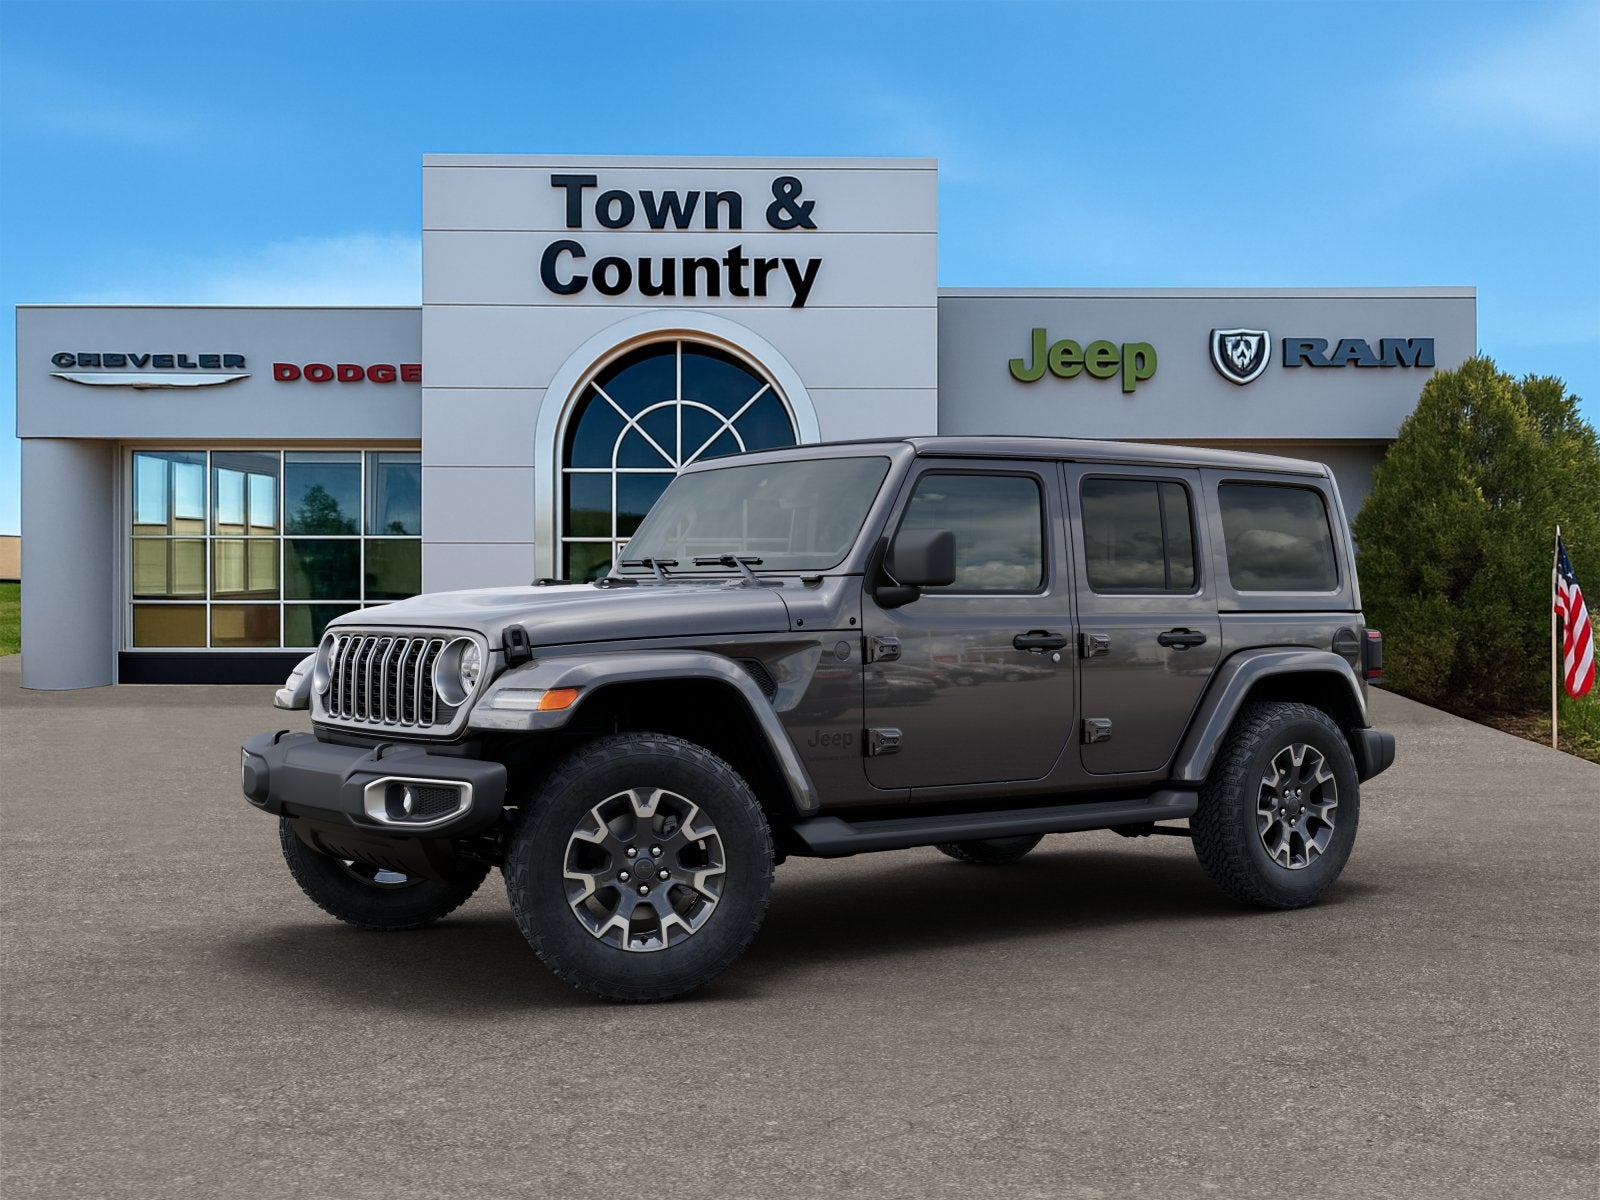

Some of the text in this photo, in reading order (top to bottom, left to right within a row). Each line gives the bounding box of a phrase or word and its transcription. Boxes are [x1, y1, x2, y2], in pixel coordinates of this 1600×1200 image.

[551, 174, 818, 230] Town &
[540, 239, 822, 308] Country
[273, 362, 422, 383] DODGE
[1008, 327, 1157, 393] Jeep
[1282, 337, 1435, 368] RAM
[808, 729, 853, 749] Jeep
